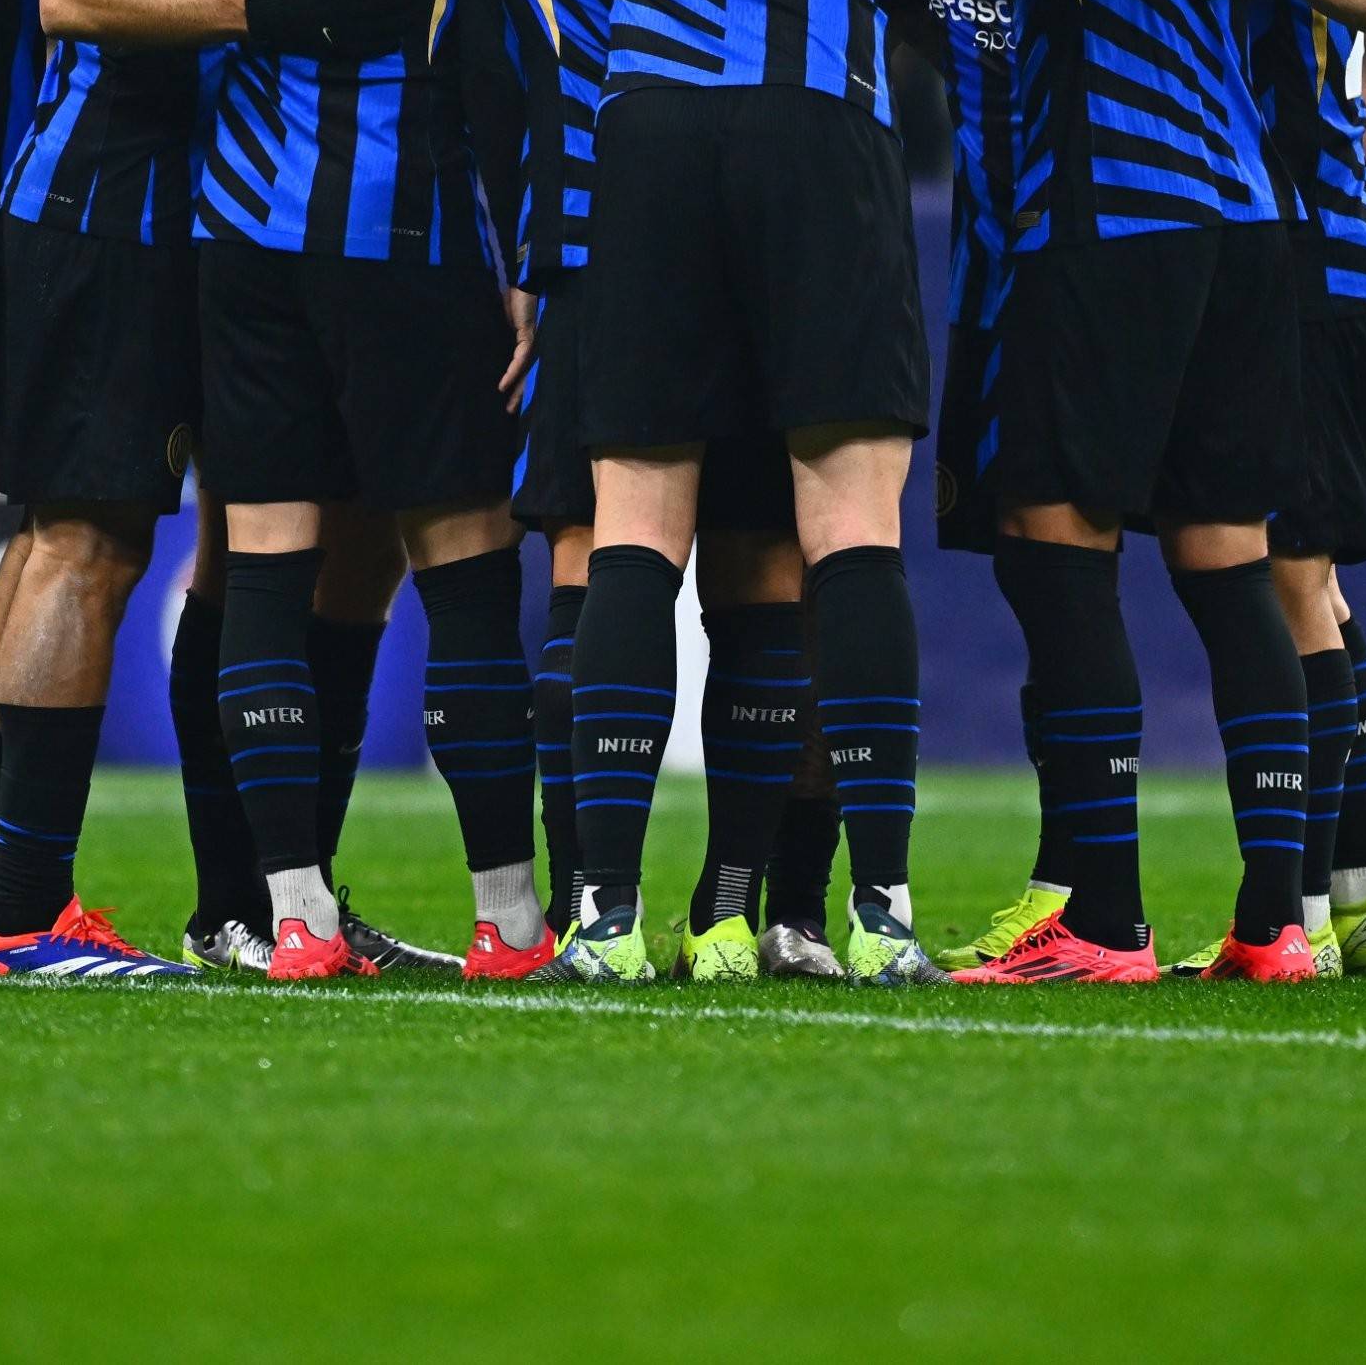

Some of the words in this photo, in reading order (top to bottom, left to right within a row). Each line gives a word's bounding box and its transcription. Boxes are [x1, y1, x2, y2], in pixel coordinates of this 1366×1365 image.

[242, 707, 305, 728] INTER
[731, 705, 796, 723] INTER
[597, 737, 654, 754] INTER
[1256, 772, 1303, 792] INTER
